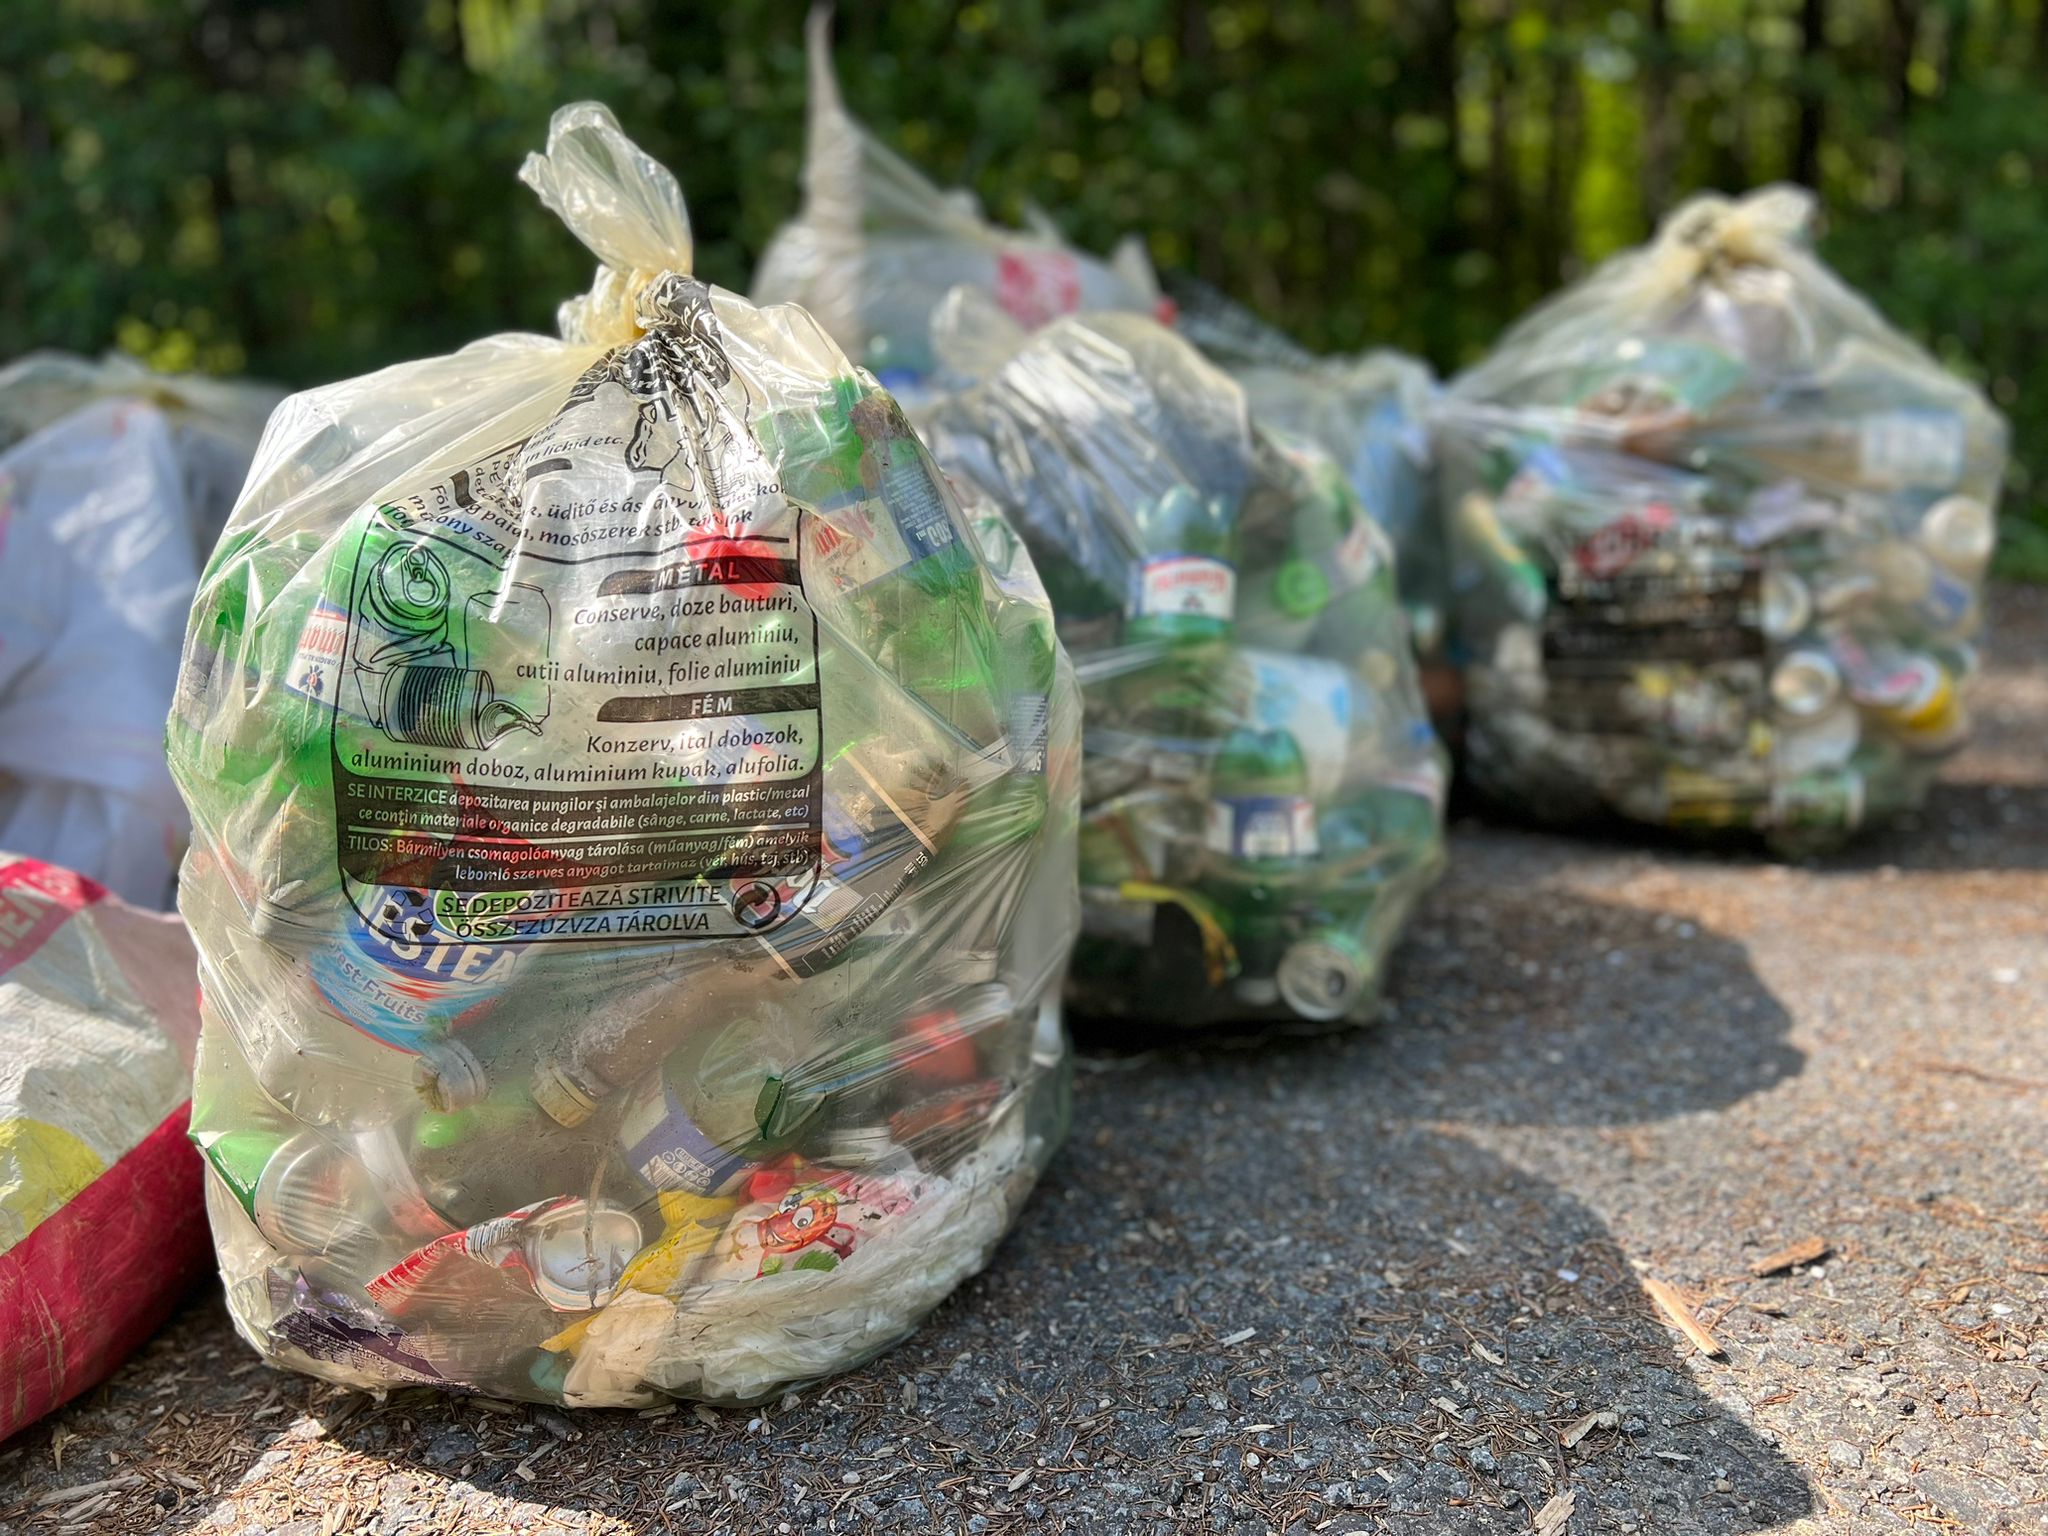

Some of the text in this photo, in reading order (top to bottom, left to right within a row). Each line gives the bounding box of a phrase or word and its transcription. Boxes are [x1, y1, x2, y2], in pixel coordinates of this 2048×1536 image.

[544, 437, 591, 457] lichid
[593, 435, 624, 446] etc.
[600, 499, 617, 513] és
[539, 519, 650, 547] mosószerek
[656, 562, 741, 588] METAL
[574, 592, 798, 625] Conserve, doze bauturi,
[634, 625, 799, 655] capace aluminiu,
[516, 655, 800, 686] cutii aluminiu, folie aluminiu
[691, 694, 733, 716] FÉM
[587, 725, 803, 754] Konzerv, ital dobozok,
[351, 749, 804, 784] aluminium doboz, aluminium kupak, alufolia.
[347, 783, 365, 798] SE
[368, 785, 447, 804] INTERZICE
[449, 792, 529, 811] depozitarea
[533, 797, 593, 815] pungilor
[610, 792, 694, 810] ambalajelor
[698, 790, 720, 804] din
[722, 785, 810, 805] plastic/metal
[359, 809, 373, 820] ce
[420, 812, 486, 829] materiale
[488, 816, 549, 835] organice
[551, 813, 634, 835] degradabile
[637, 811, 687, 831] (sânge,
[689, 811, 730, 825] carne,
[733, 807, 781, 822] lactate,
[785, 804, 809, 818] etc)
[348, 831, 809, 863] TILOS: Bármilyen csomagolóanyag tárolása (műanyag/fém) amelyik
[455, 865, 510, 881] lebomló
[513, 868, 564, 880] szerves
[567, 864, 624, 879] anyagot
[471, 886, 624, 913] DEPOZITEAZĂ
[627, 885, 721, 905] STRIVITE
[456, 910, 709, 938] ÖSSZEZÚZVZA TÁROLVA
[362, 976, 427, 1024] Fruits
